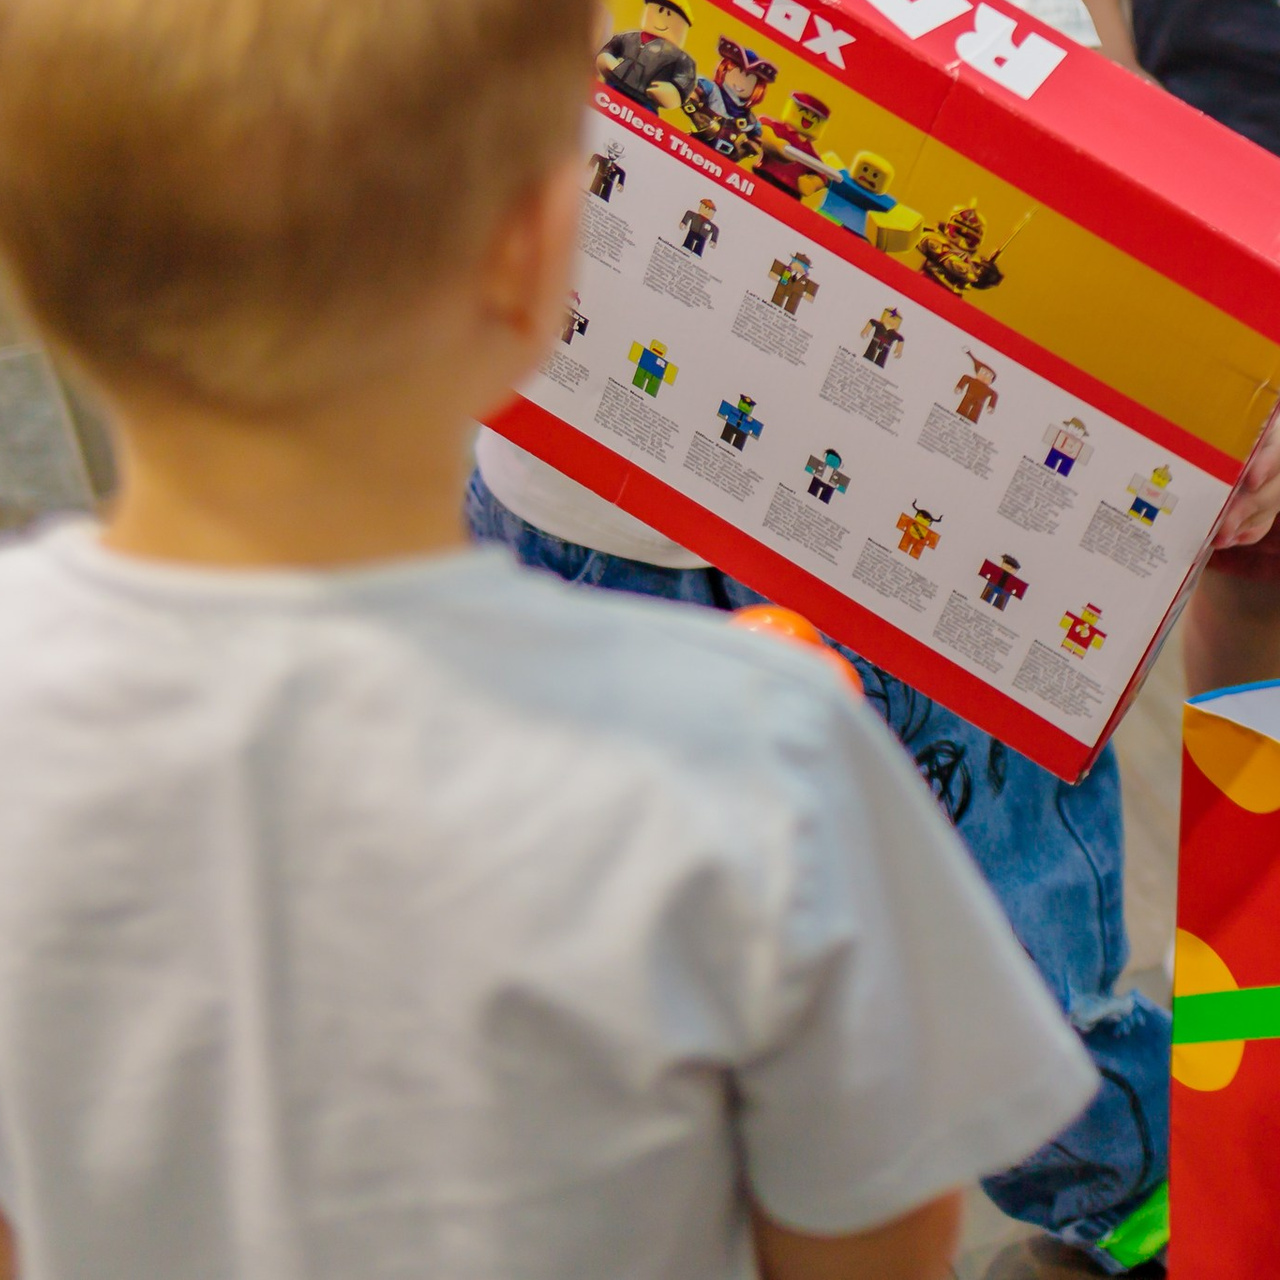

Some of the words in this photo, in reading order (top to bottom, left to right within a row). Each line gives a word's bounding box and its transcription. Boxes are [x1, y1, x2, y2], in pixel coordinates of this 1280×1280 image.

[594, 91, 664, 144] Collect
[668, 132, 724, 178] Them
[726, 170, 757, 197] All
